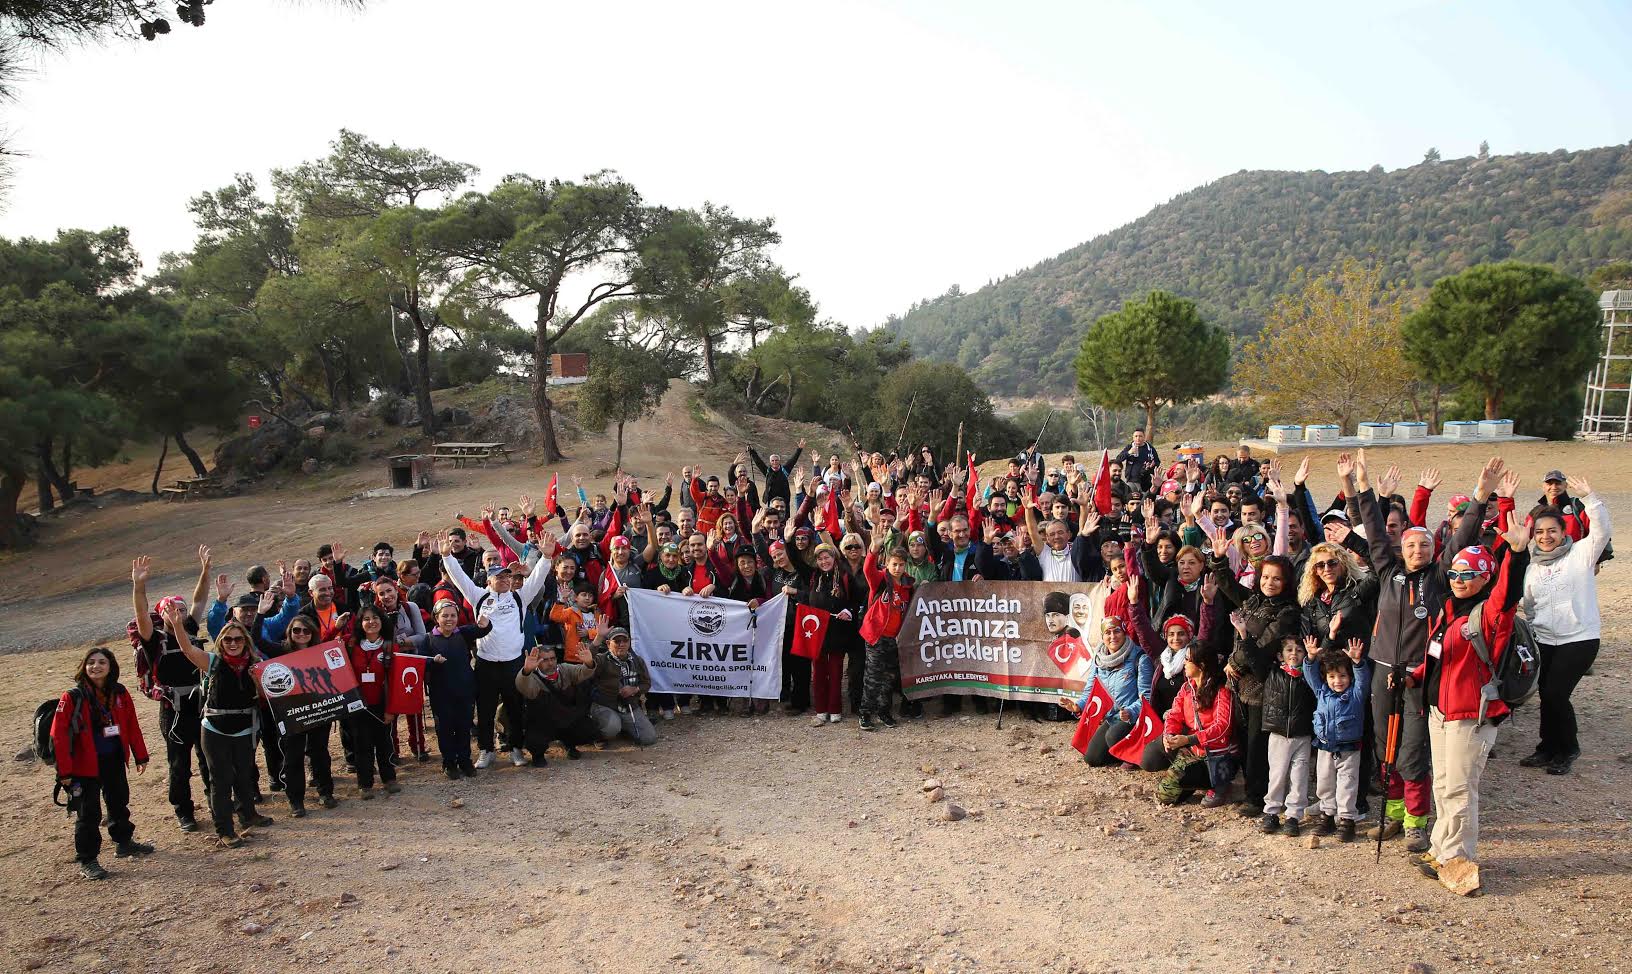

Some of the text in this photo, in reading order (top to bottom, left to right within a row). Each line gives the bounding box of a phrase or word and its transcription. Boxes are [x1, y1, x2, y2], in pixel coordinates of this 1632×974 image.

[915, 593, 1021, 616] Anamızdan
[918, 615, 1020, 640] Atamıza
[670, 638, 748, 661] ZİRVE
[920, 638, 1022, 667] Çiçeklerle
[650, 660, 688, 670] DAĞCILIK
[702, 663, 727, 672] DOĞA
[728, 664, 767, 672] SPORLARI
[673, 682, 748, 690] www.zirvedagcilik.org
[692, 674, 727, 682] KULÜBÜ
[915, 673, 953, 684] KARŞIYAKA
[286, 704, 311, 717] ZİRVE
[312, 694, 346, 710] DAĞCILIK
